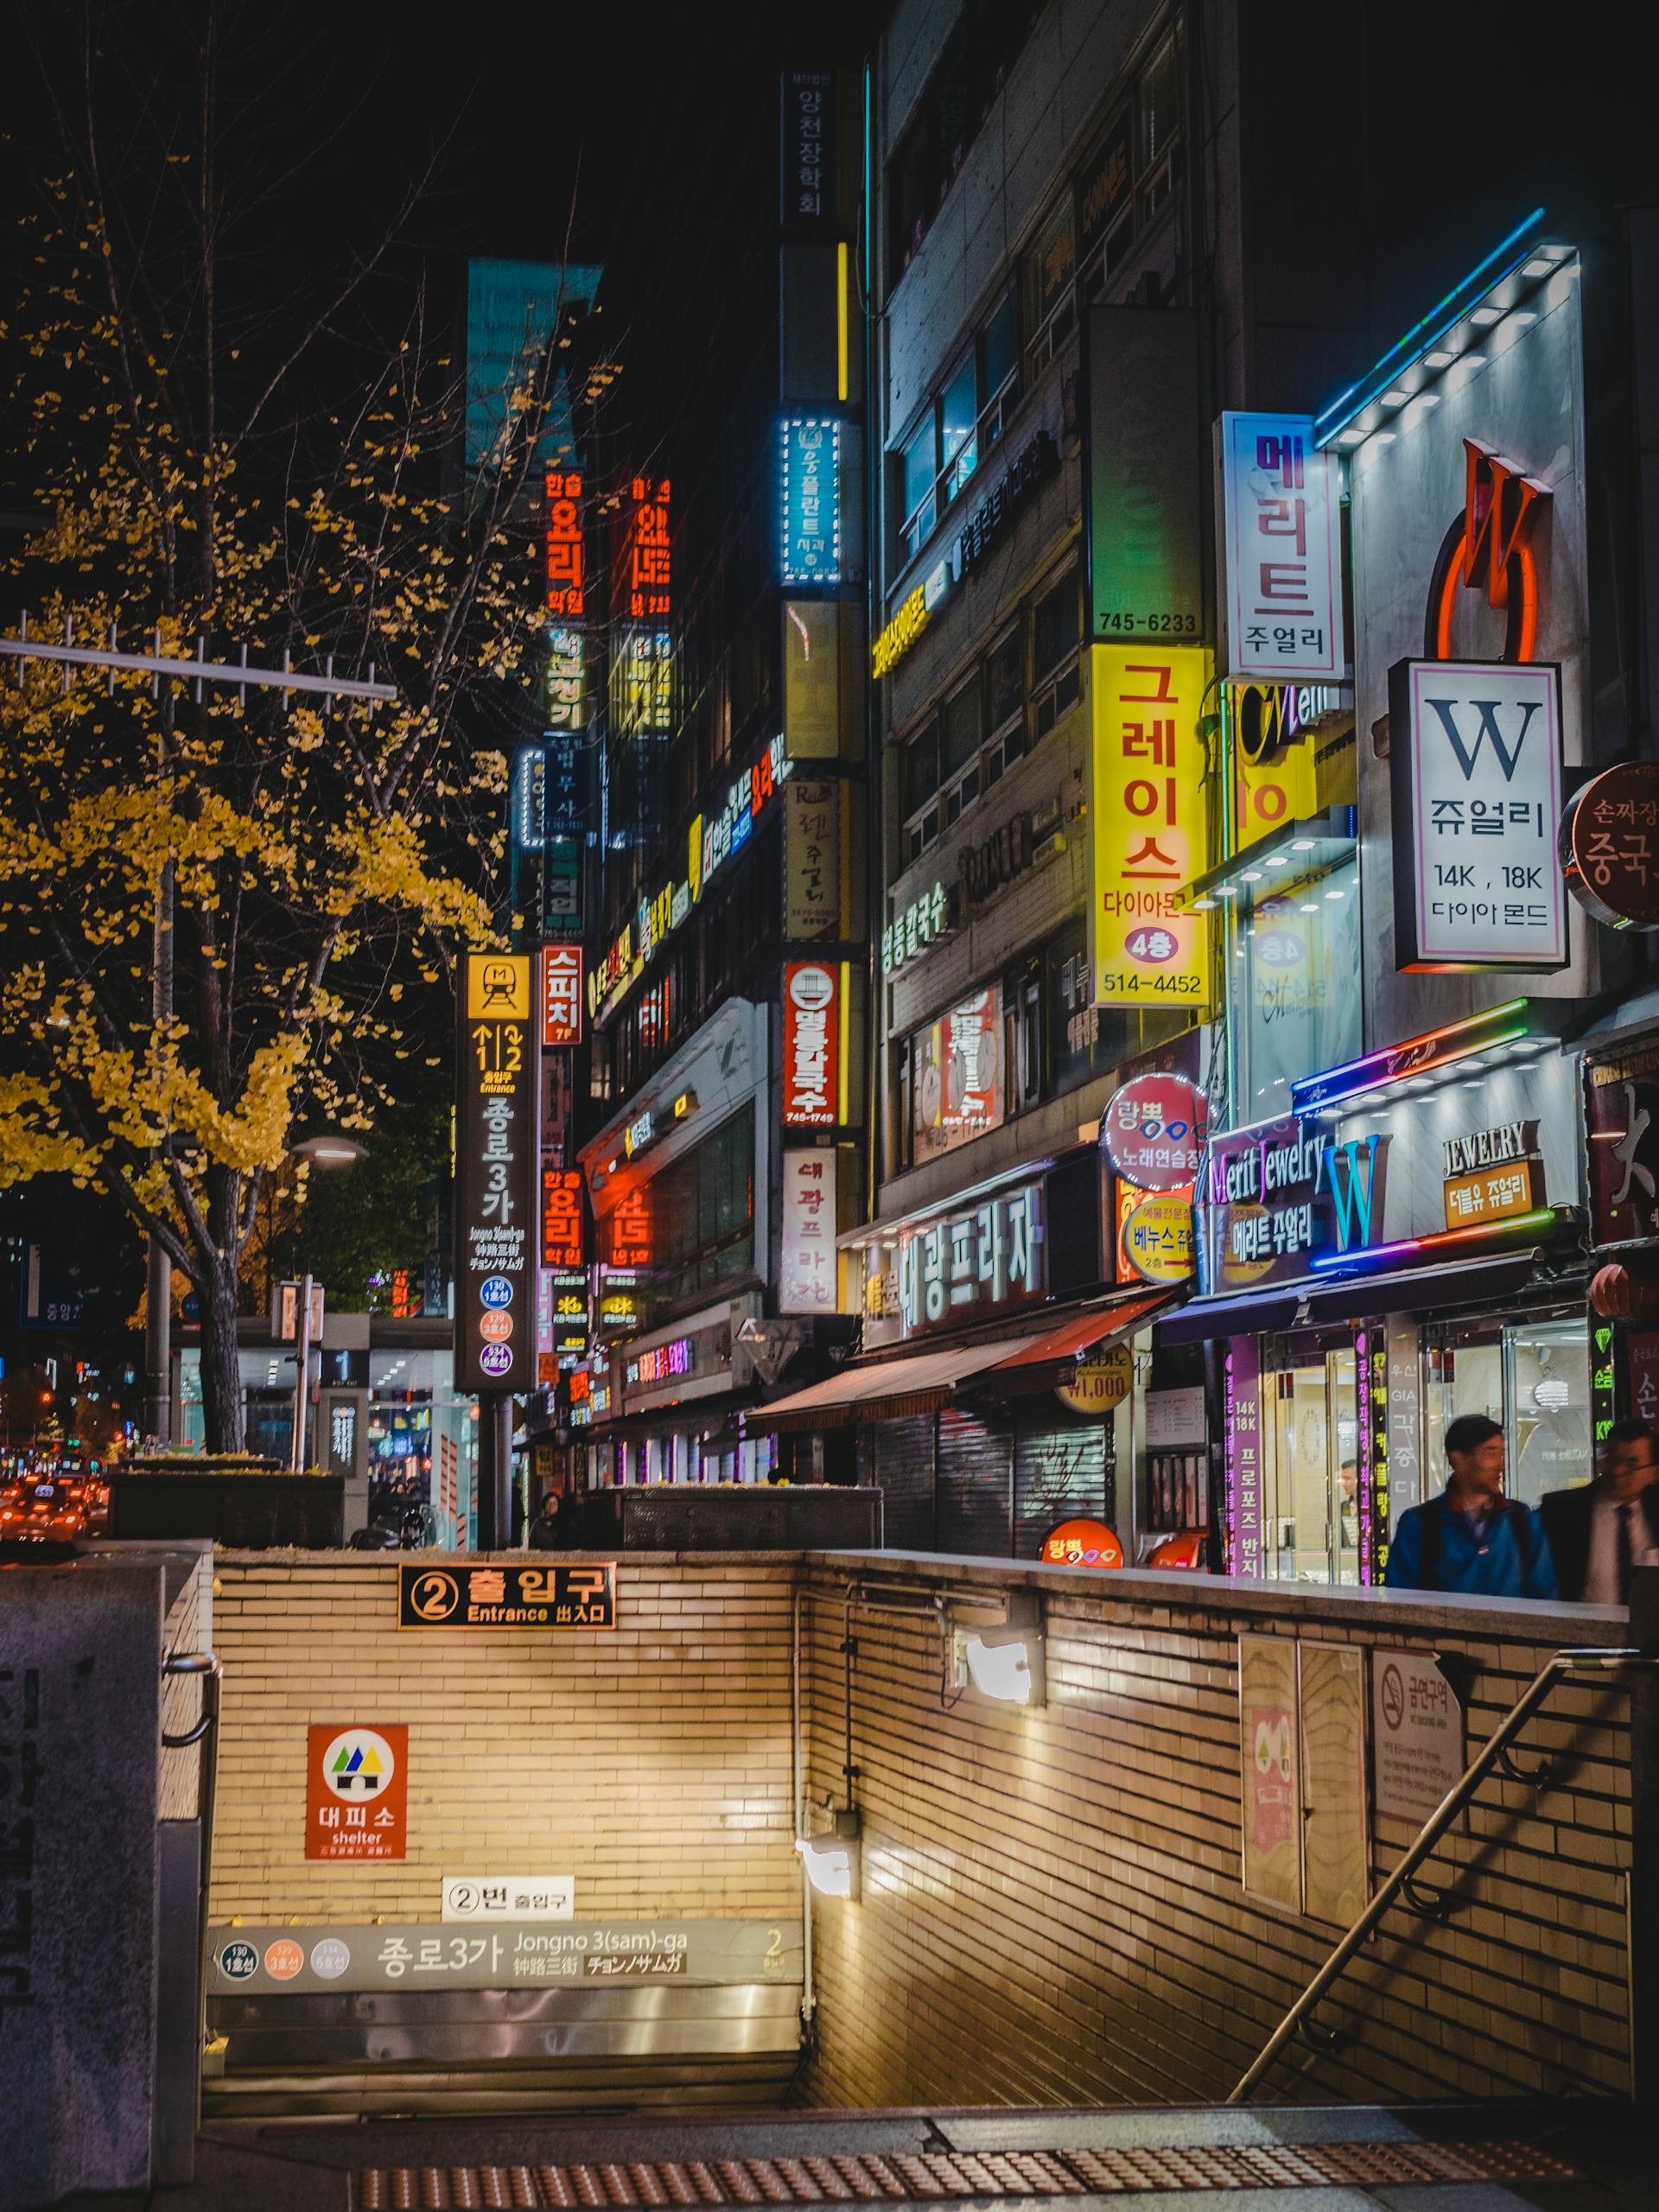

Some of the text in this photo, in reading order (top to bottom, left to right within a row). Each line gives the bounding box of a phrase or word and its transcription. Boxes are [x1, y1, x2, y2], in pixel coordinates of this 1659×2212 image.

[1255, 435, 1314, 616] 메리트
[1100, 613, 1196, 632] 745-6233
[1244, 626, 1323, 655] 주얼리
[1424, 699, 1543, 783] W
[1118, 664, 1182, 879] 그레이스
[1431, 800, 1544, 838] 쥬얼리
[1592, 798, 1659, 826] 손짜장
[1586, 832, 1659, 887] 중국
[1502, 866, 1543, 889] 18K
[1432, 902, 1548, 926] 다이아몬드
[882, 881, 947, 976] 명동칼국수
[1131, 931, 1173, 958] 4층
[548, 951, 578, 1028] 스피치
[1104, 974, 1202, 994] 514-4452
[555, 1027, 573, 1040] 7F
[476, 1046, 522, 1071] 1 2
[480, 1083, 516, 1094] Entrance
[481, 1097, 516, 1224] 종로3가
[1122, 1147, 1201, 1170] 노래연습장
[1442, 1121, 1527, 1179] JEWELRY
[1209, 1123, 1327, 1205] Merit Jewelry
[1322, 1134, 1381, 1252] W
[1448, 1173, 1526, 1216] 더블유 쥬얼리
[544, 1189, 581, 1249] 요리
[469, 1226, 493, 1243] Jongno
[1134, 1224, 1175, 1253] 베누스
[1232, 1202, 1313, 1262] 메리트 주얼리
[485, 1290, 510, 1303] 1호선
[484, 1323, 510, 1336] 3호선
[484, 1357, 510, 1369] 5호선
[1390, 1364, 1417, 1377] 우신
[1235, 1400, 1255, 1415] 14K
[1390, 1389, 1417, 1402] GIA
[1236, 1416, 1256, 1431] 18K
[1239, 1447, 1257, 1529] 프로포즈
[1241, 1537, 1259, 1579] 반지
[467, 1569, 605, 1604] 출입구
[467, 1604, 605, 1624] Entrance 出入口
[319, 1806, 395, 1828] 대피소
[332, 1829, 382, 1846] shelter
[514, 1893, 567, 1910] 출입구
[513, 1929, 688, 1955] Jongno 3(sam)-ga
[767, 1928, 783, 1957] 2
[226, 1956, 254, 1974] 1호선
[270, 1955, 300, 1972] 3호선
[315, 1955, 346, 1971] 5호선
[378, 1934, 505, 1978] 종로3가
[587, 1952, 683, 1976] チョンノサムガ
